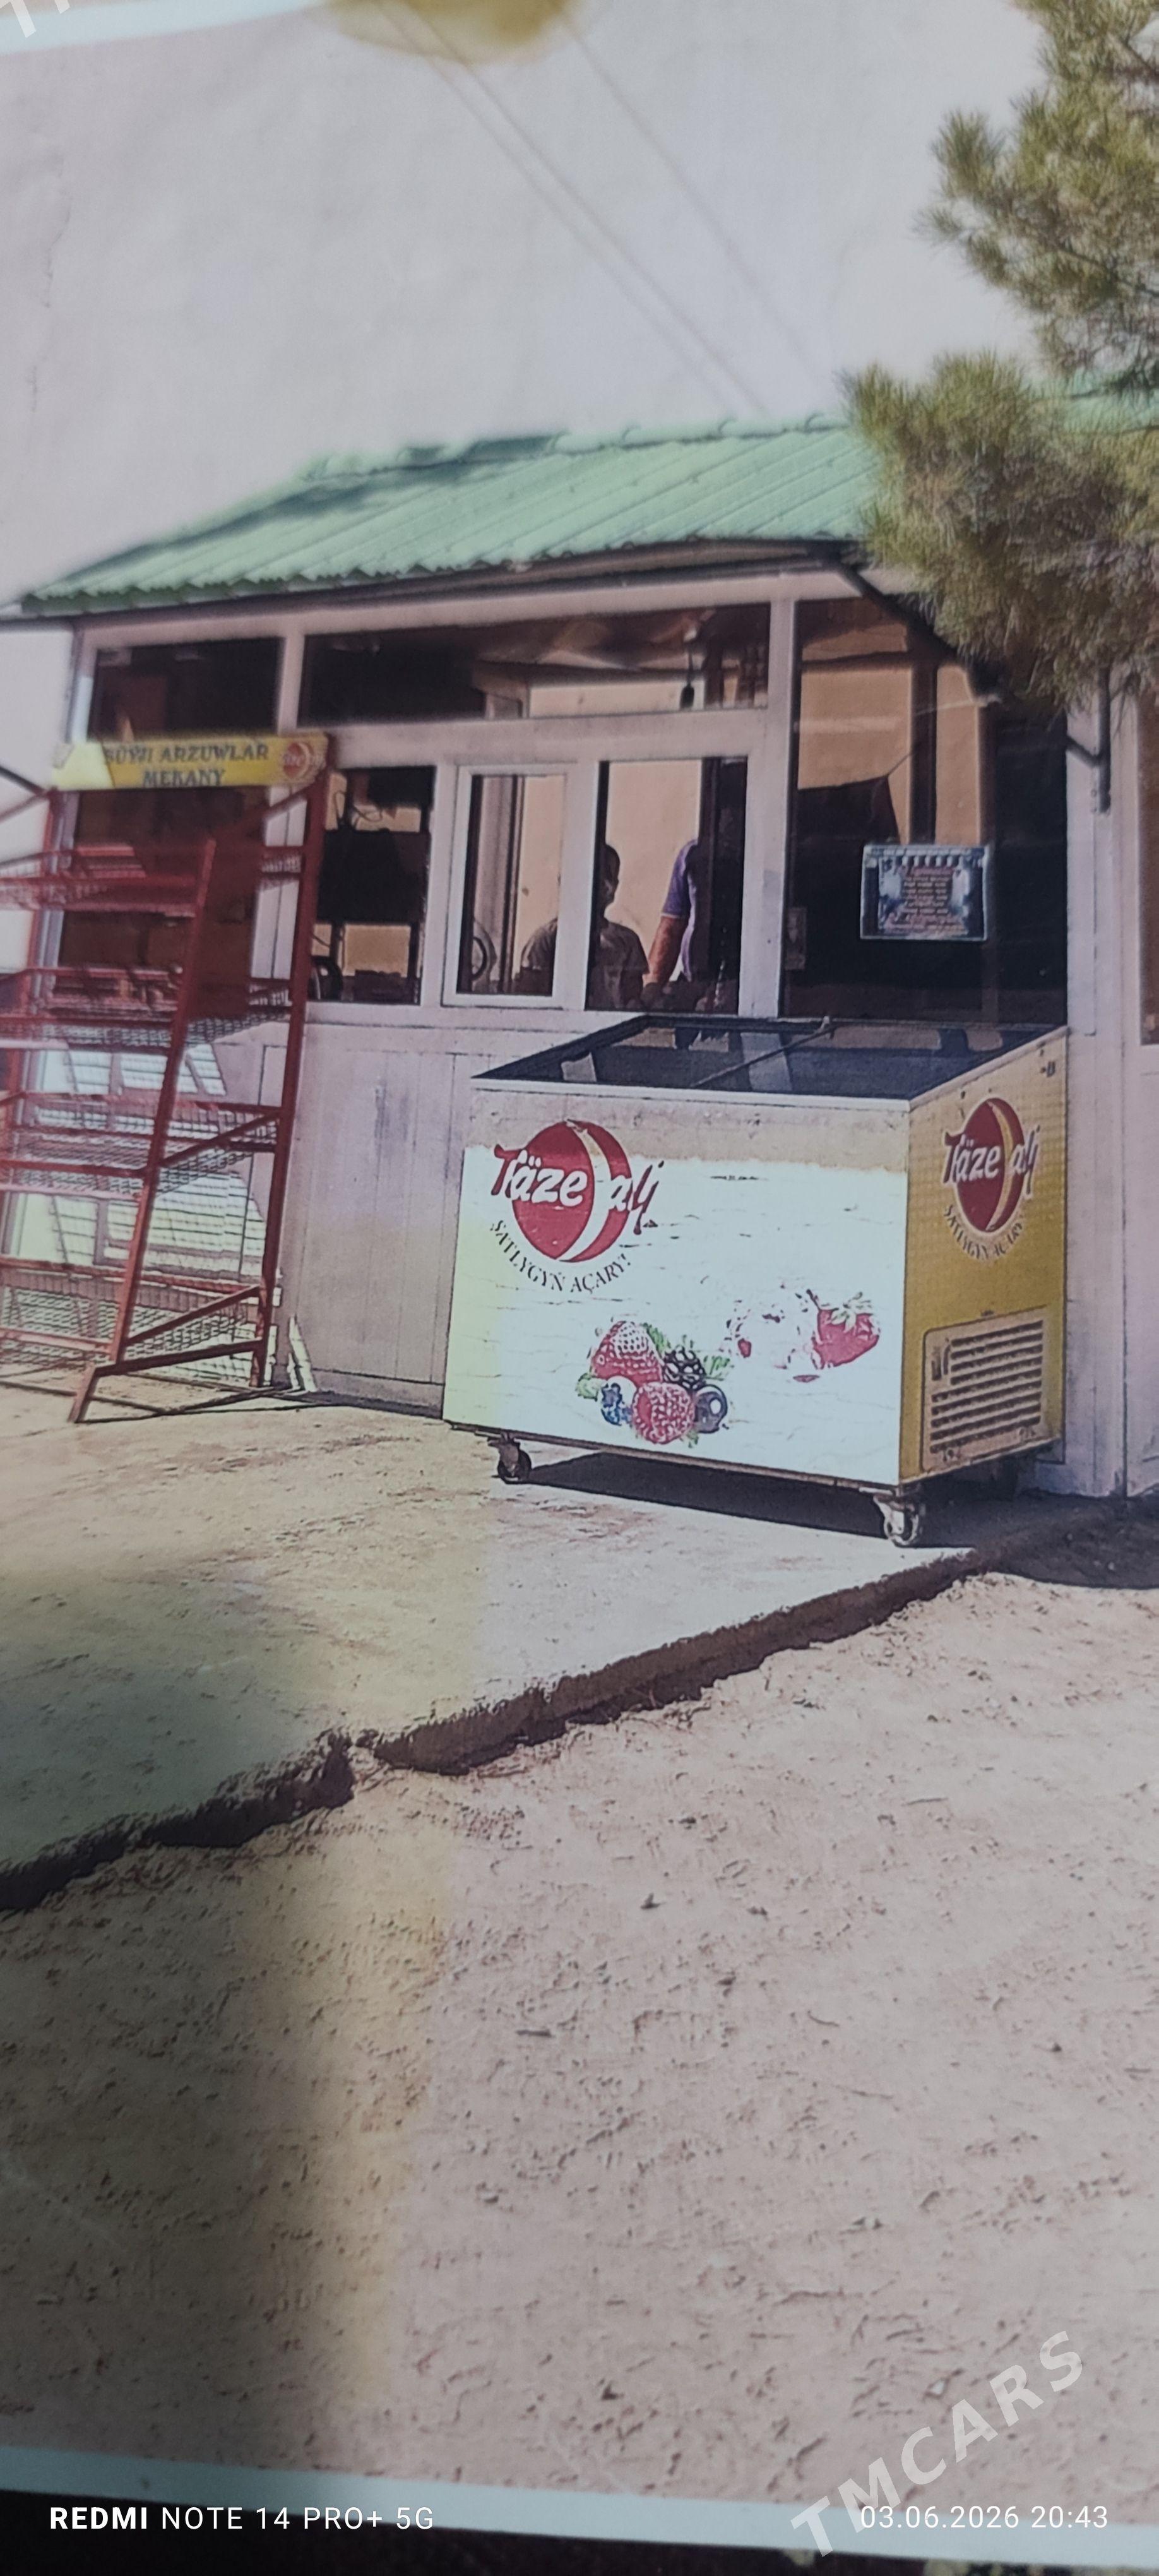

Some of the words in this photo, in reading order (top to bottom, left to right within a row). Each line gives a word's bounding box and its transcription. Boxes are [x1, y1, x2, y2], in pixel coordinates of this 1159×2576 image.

[159, 743, 269, 763] ARZUWLAR
[143, 768, 226, 788] MEKANY
[490, 1143, 588, 1207] Täze
[943, 1131, 1001, 1184] Täze
